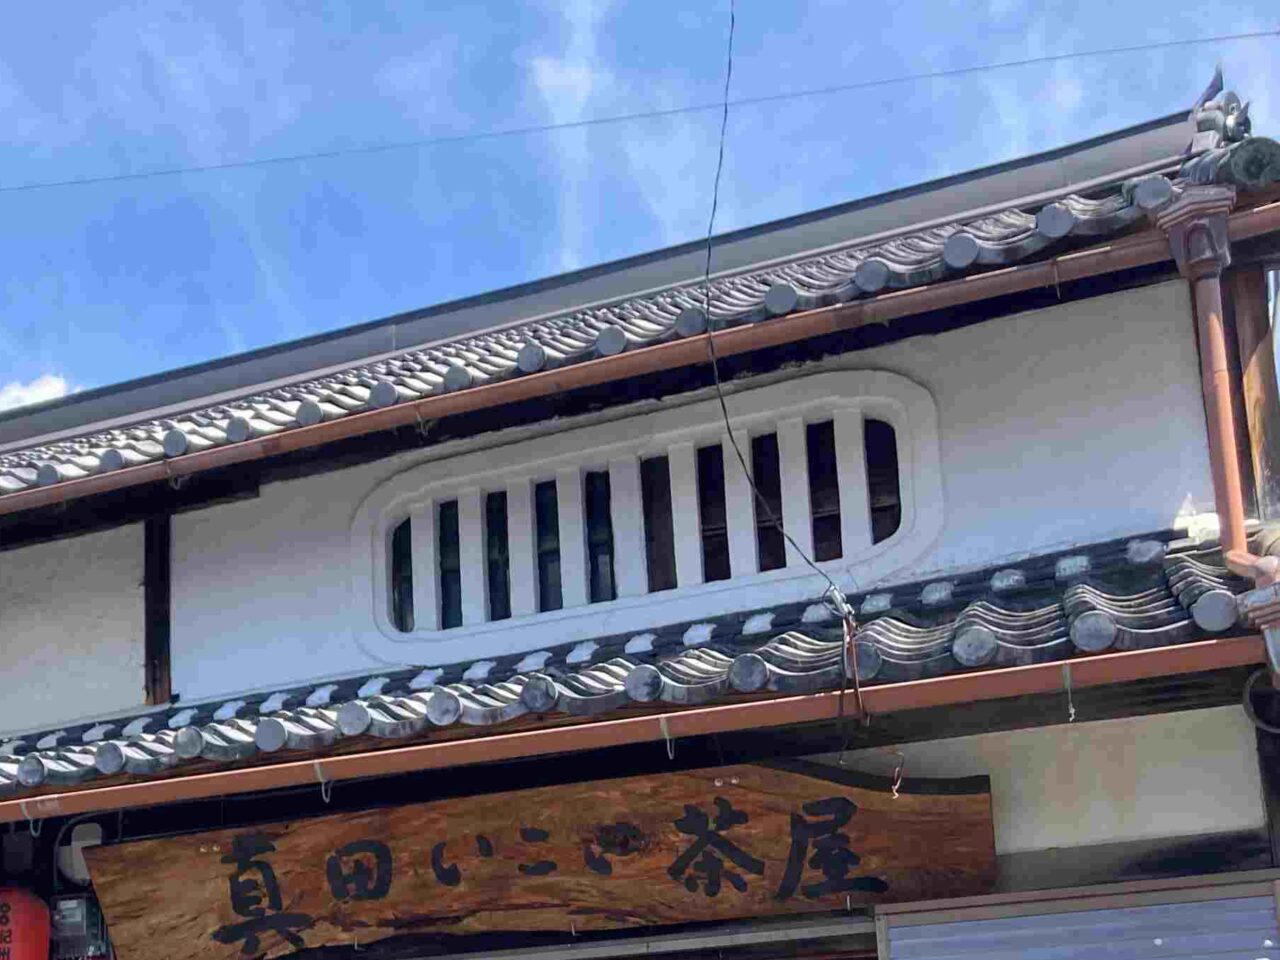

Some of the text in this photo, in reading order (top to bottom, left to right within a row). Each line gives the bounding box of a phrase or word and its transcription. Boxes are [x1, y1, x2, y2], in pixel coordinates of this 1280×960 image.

[213, 796, 889, 955] 真田いこい茶屋
